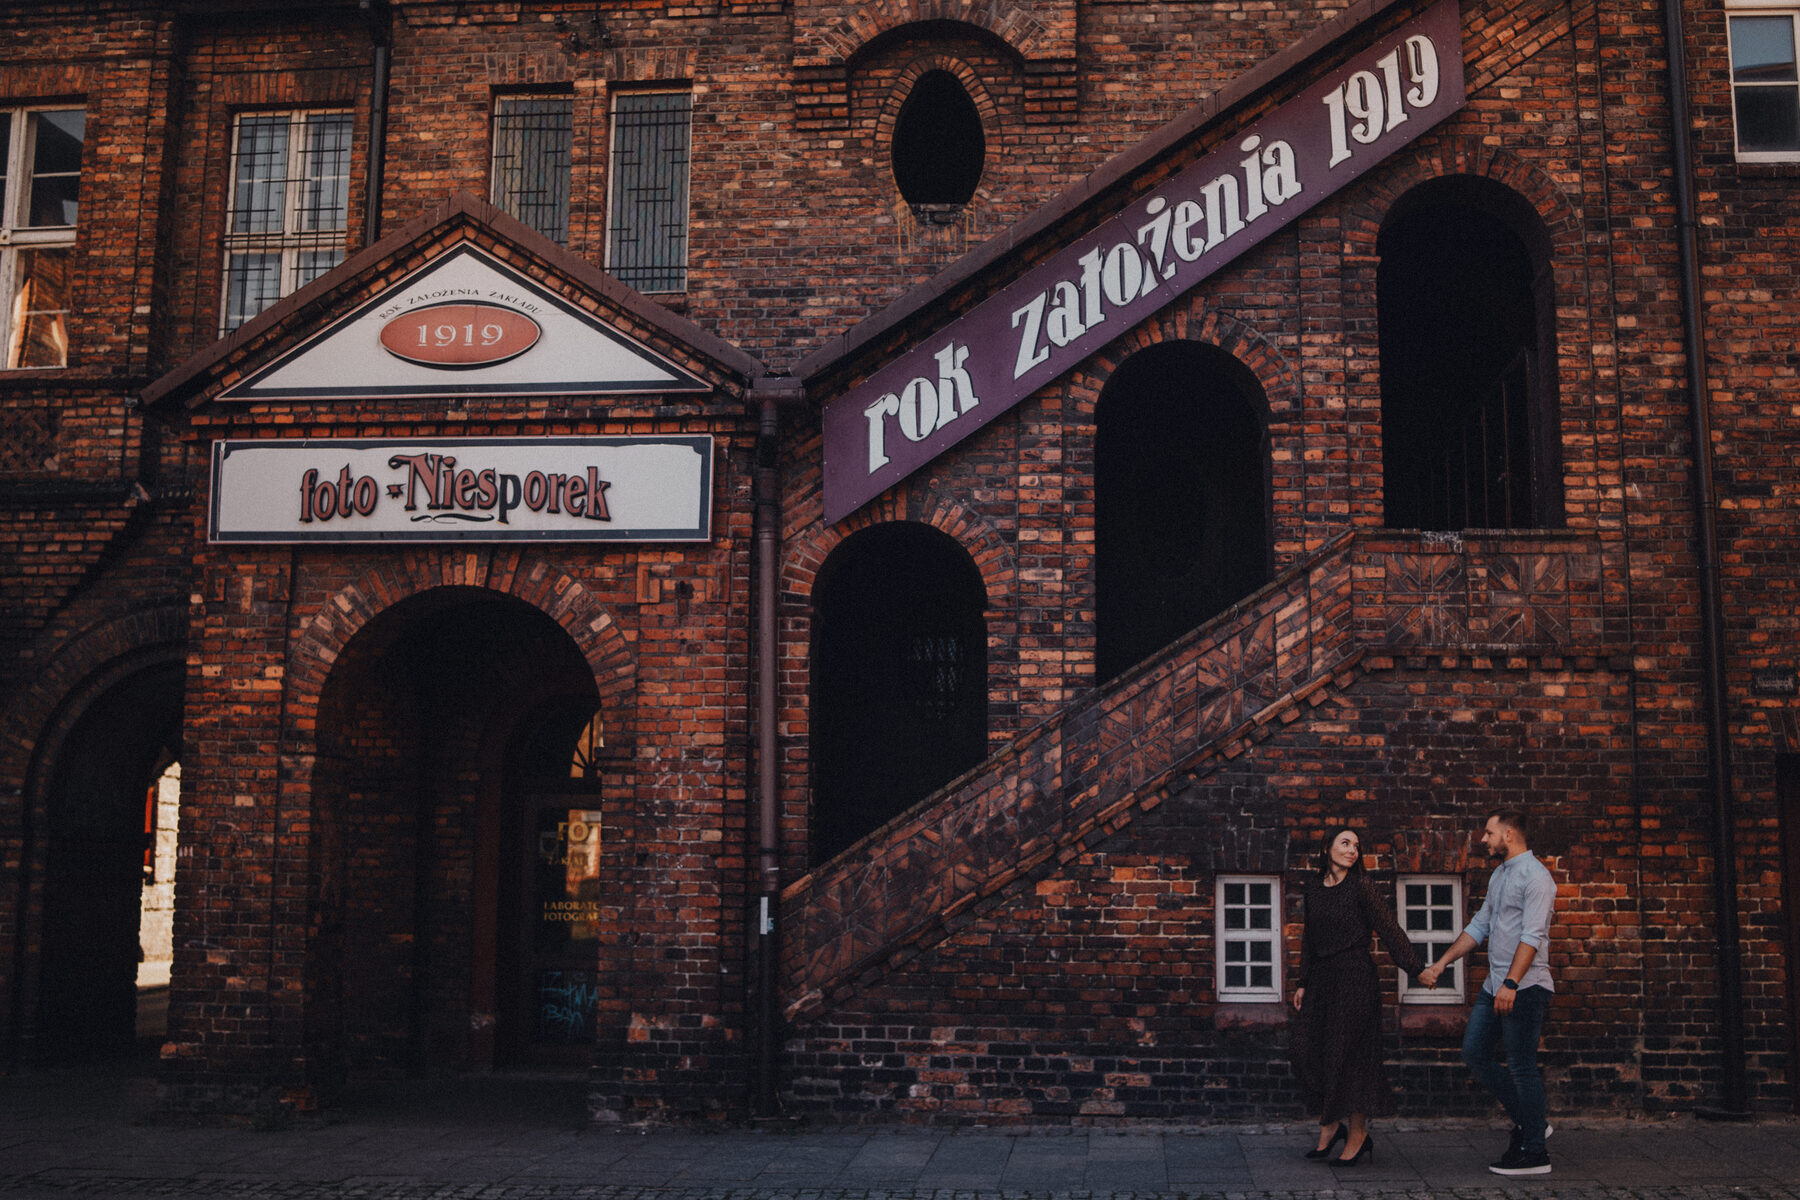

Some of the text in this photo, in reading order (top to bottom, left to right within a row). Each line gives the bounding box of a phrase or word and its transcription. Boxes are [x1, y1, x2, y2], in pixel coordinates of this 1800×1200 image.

[864, 341, 980, 475] rok
[1322, 34, 1441, 169] 1919
[379, 303, 403, 320] ROK
[417, 324, 504, 347] 1919
[299, 462, 379, 523] foto
